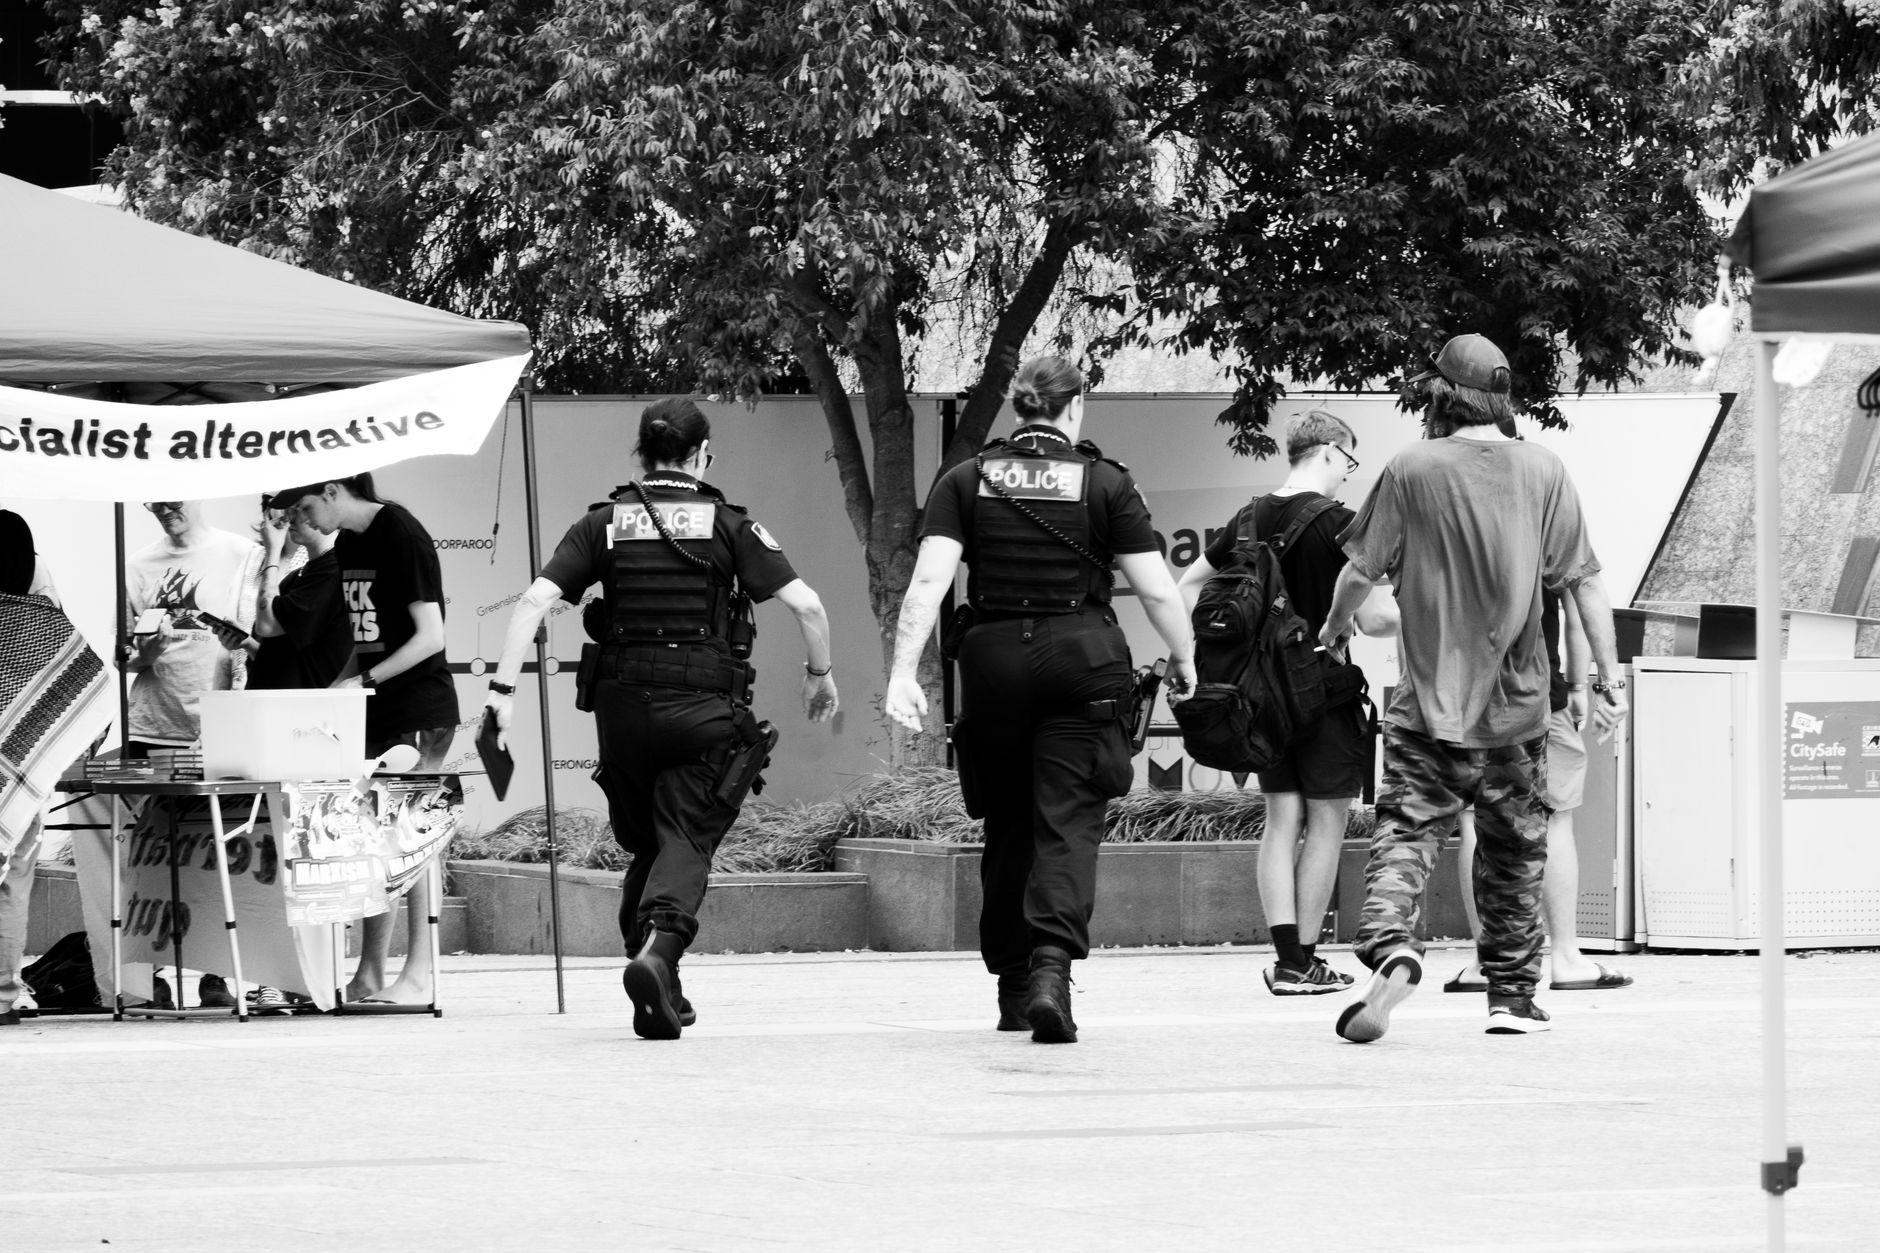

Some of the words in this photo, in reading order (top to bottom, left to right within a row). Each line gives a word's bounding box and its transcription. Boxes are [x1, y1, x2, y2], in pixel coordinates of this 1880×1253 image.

[168, 411, 445, 459] alternative
[989, 467, 1074, 490] POLICE
[1790, 742, 1847, 761] CitySafe
